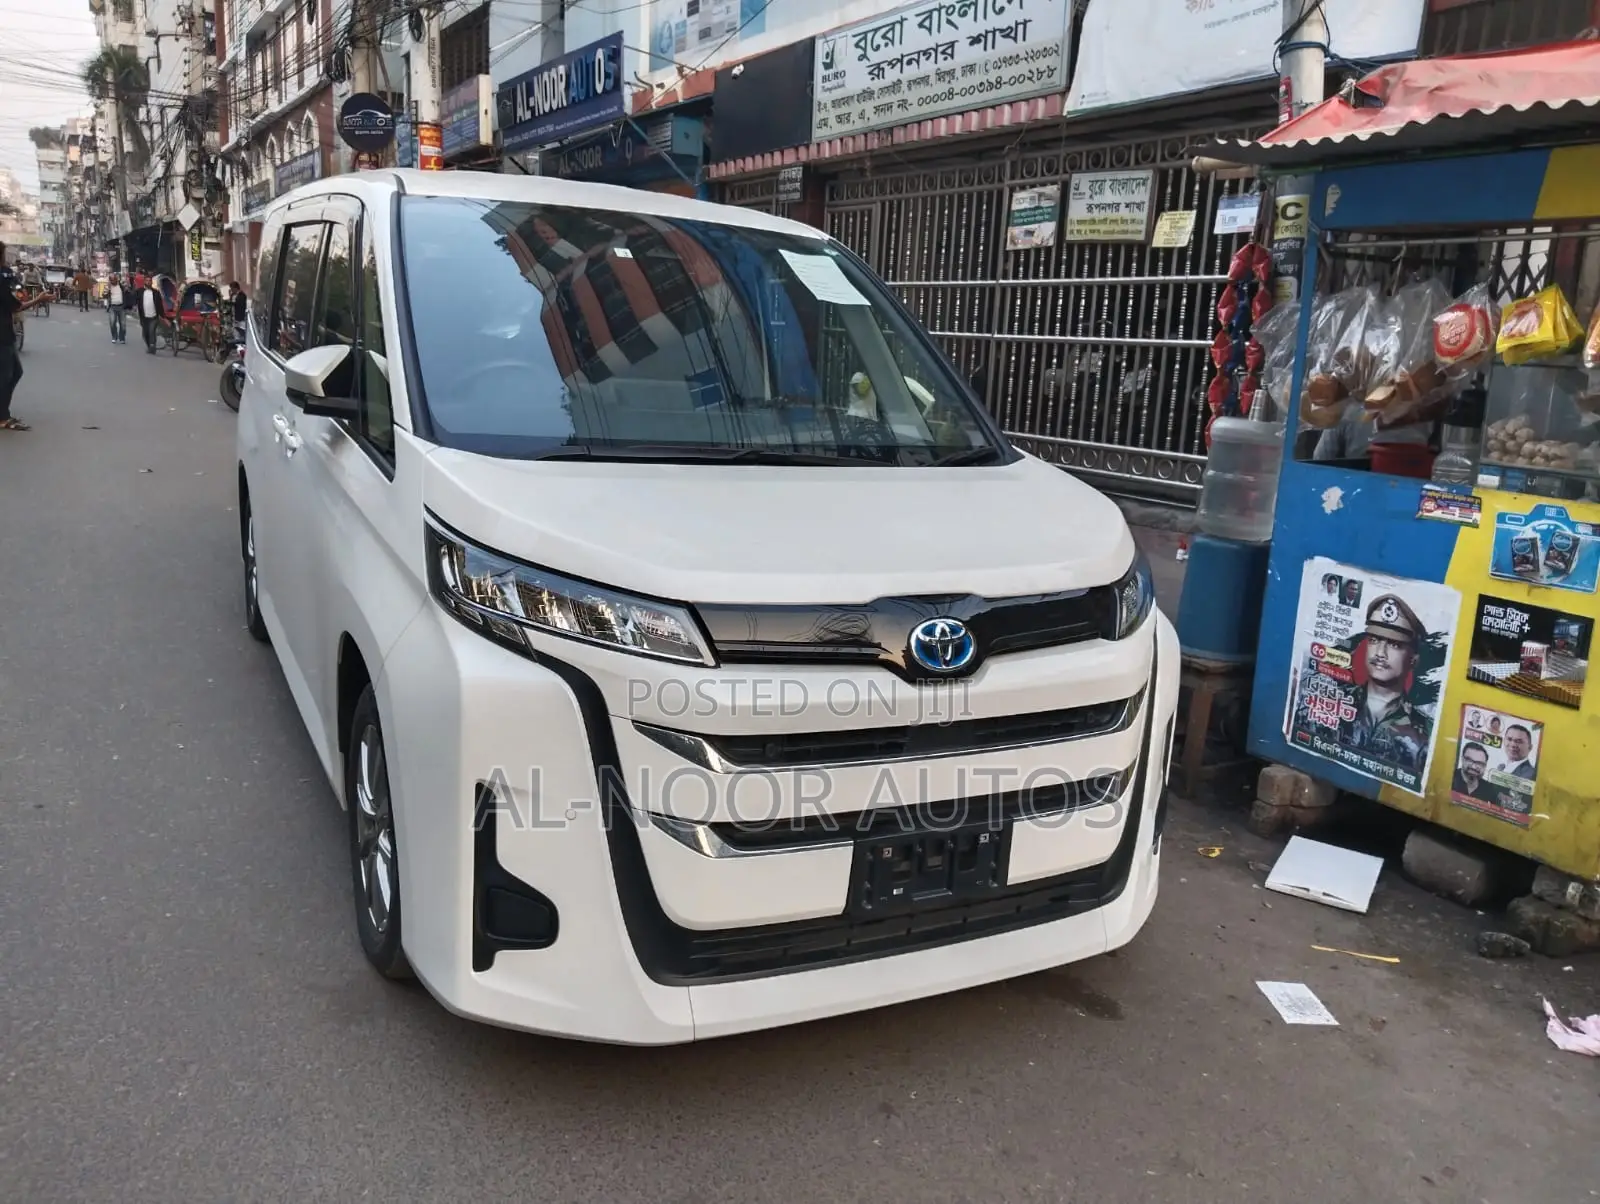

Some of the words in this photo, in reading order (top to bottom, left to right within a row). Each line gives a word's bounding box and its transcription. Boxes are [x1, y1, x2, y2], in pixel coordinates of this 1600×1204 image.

[852, 15, 908, 62] বুরো
[866, 40, 959, 81] রূপনগর
[966, 18, 1033, 52] শাখা
[516, 64, 567, 124] AL-NOOR
[569, 45, 618, 104] AUTOS
[821, 70, 846, 84] BURO
[1088, 179, 1107, 200] বুরো
[1109, 176, 1150, 196] বাংলাদেশ
[1124, 200, 1146, 214] শাখা
